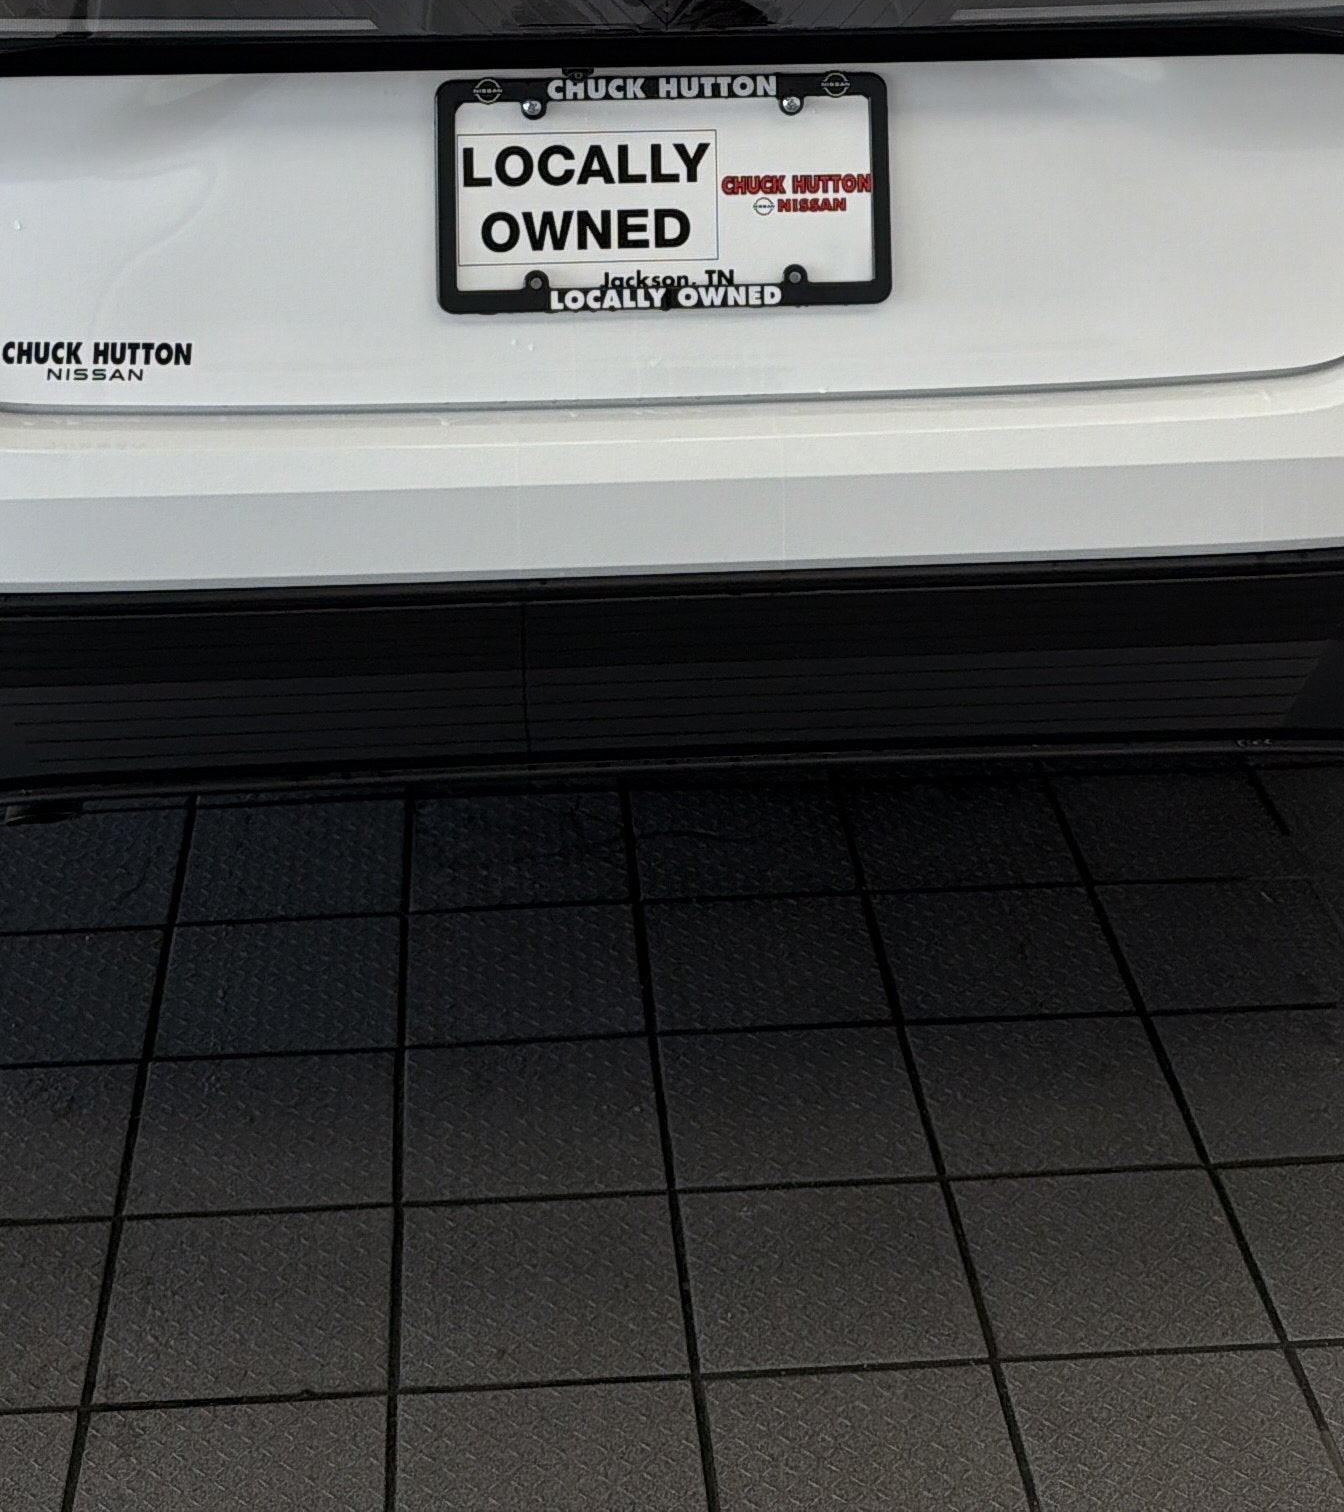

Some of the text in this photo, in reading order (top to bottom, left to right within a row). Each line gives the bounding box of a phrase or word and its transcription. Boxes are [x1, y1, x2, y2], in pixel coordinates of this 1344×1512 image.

[547, 75, 777, 100] CHUCK HUTTON
[462, 143, 711, 187] LOCALLY
[721, 173, 873, 196] CHUCK HUTTON
[777, 198, 847, 212] NISSAN
[481, 208, 691, 253] OWNED
[704, 270, 735, 286] TN
[550, 284, 782, 310] LOCALLY OWNED
[2, 341, 192, 365] CHUCK HUTTON
[46, 368, 144, 381] NISSAN
